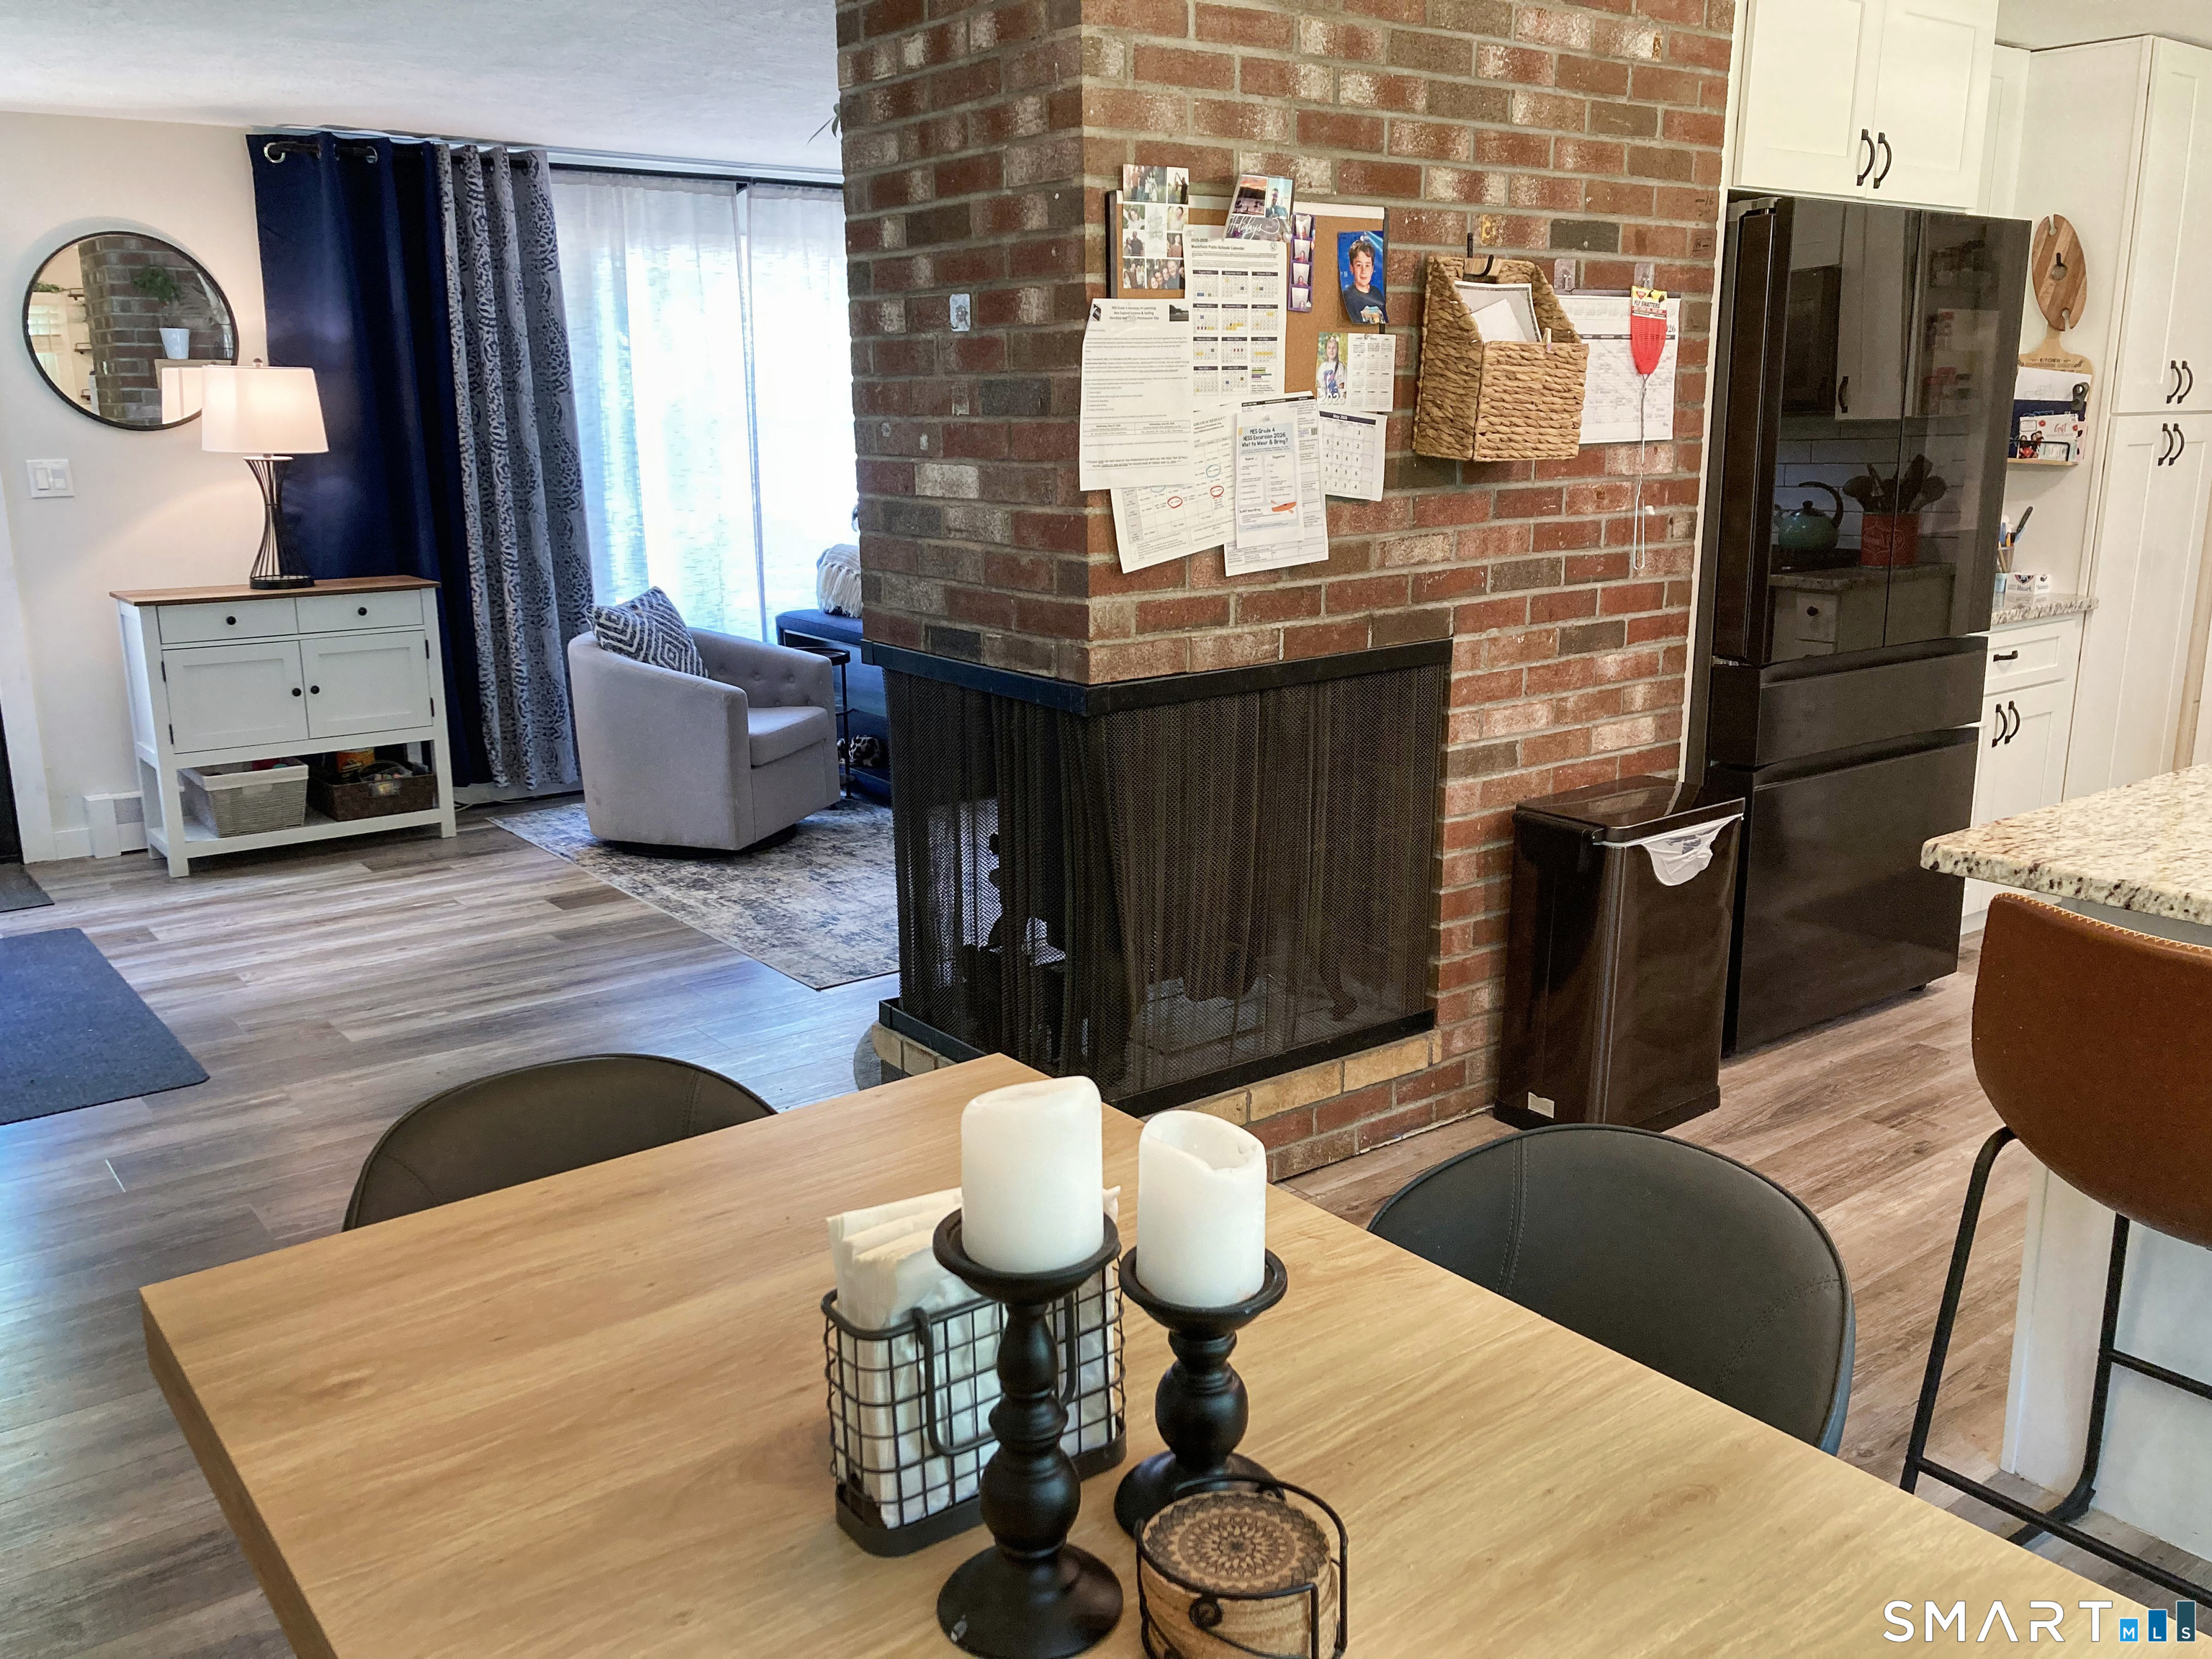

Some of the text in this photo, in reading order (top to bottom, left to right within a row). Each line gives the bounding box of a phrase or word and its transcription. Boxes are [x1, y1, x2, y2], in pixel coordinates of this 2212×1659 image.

[1226, 215, 1273, 239] Holidays
[1666, 324, 1676, 333] 26
[1319, 392, 1346, 405] 2026
